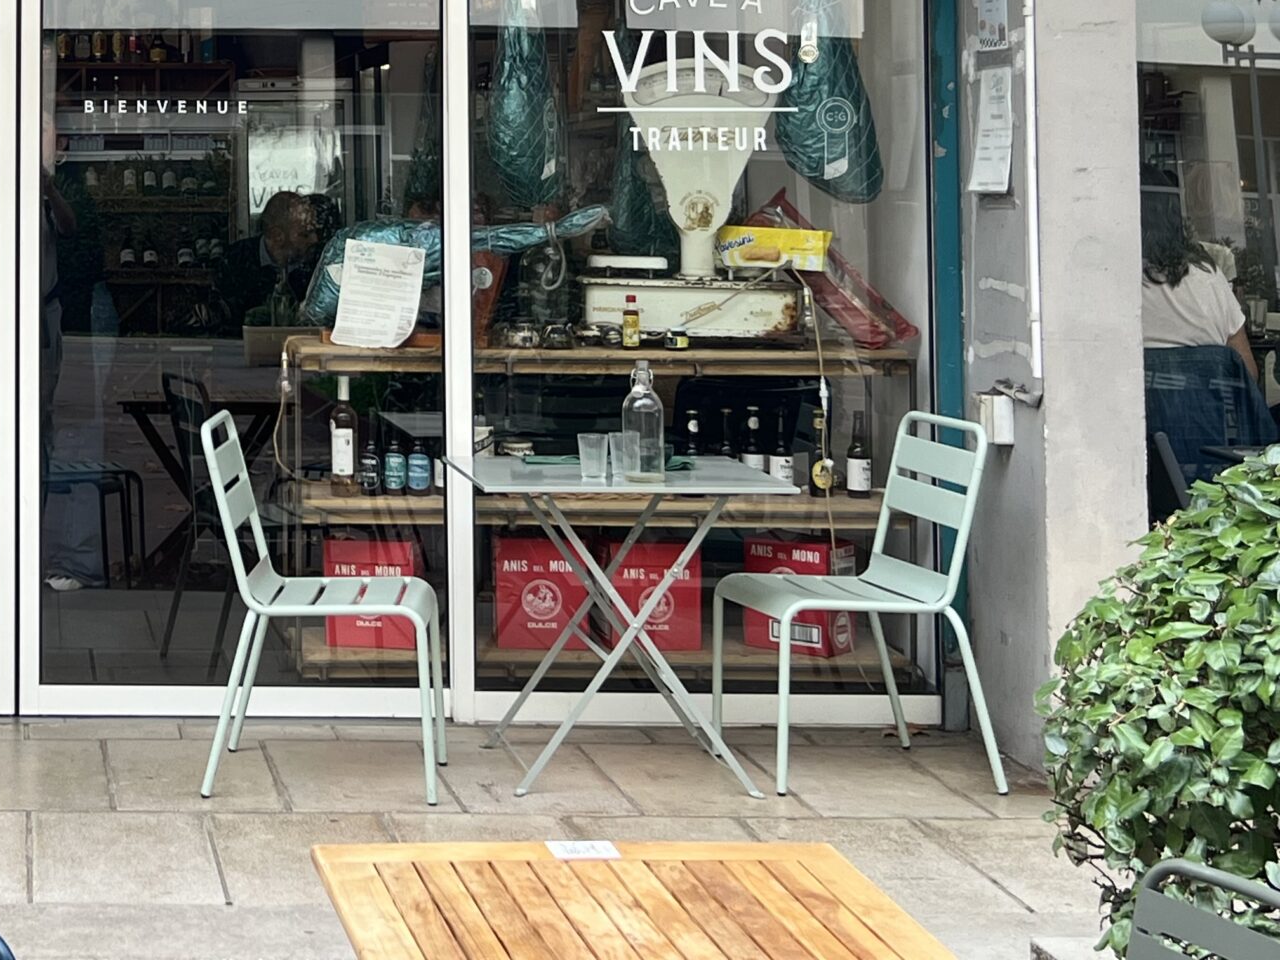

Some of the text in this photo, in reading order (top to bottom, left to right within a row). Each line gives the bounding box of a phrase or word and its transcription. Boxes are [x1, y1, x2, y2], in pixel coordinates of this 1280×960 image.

[602, 28, 793, 94] VINS
[84, 100, 248, 115] BIENVENUE
[630, 126, 768, 152] TRAITEUR
[717, 234, 754, 252] avesini
[750, 544, 773, 558] ANIS
[792, 549, 820, 564] MONO
[334, 564, 356, 576] ANIS
[375, 565, 401, 577] MONO
[503, 559, 528, 572] ANIS
[549, 559, 573, 573] MON
[623, 568, 645, 579] ANIS
